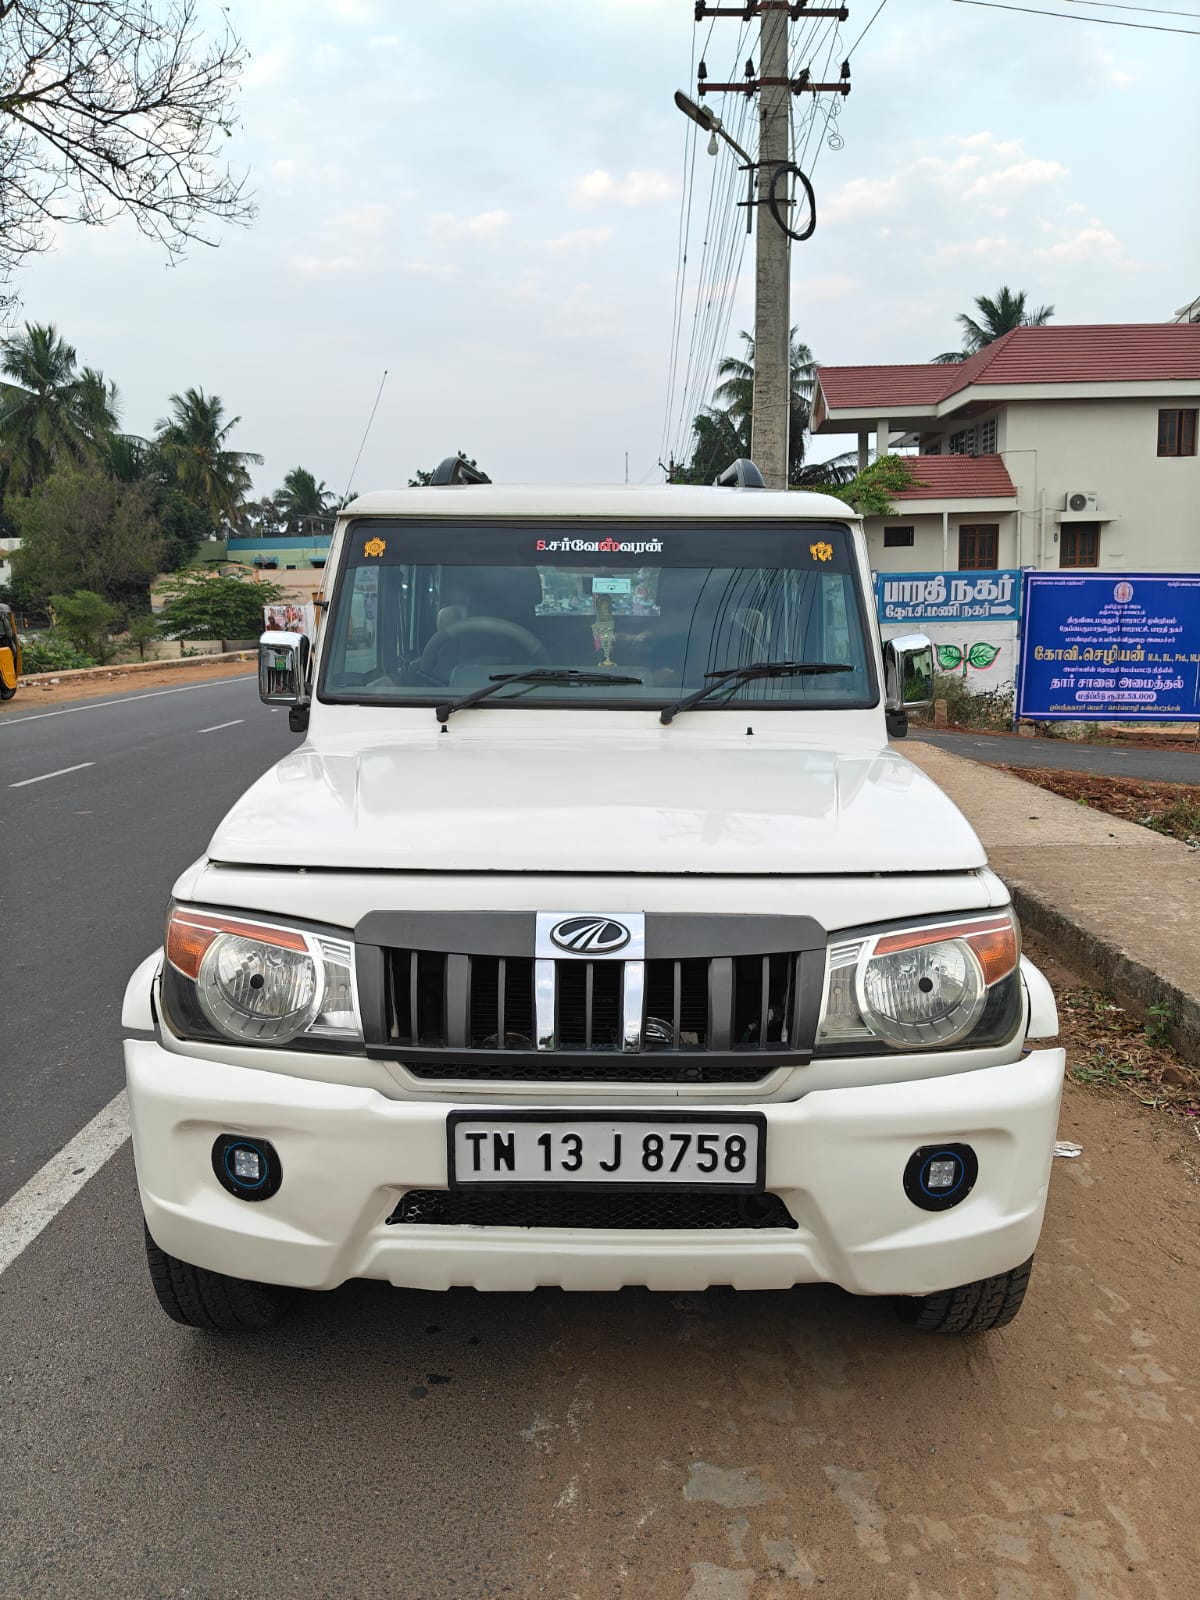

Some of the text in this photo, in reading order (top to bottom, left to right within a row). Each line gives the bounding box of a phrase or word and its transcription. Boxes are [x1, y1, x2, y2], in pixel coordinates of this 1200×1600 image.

[536, 537, 663, 554] S.சர்வேஸ்வரன்
[884, 574, 1015, 606] பாரதி நகர்
[961, 602, 990, 617] நகர்
[1034, 644, 1145, 665] கோவி.செழியன்
[1050, 674, 1184, 691] தார் சாலை அமைத்தல்
[465, 1132, 748, 1173] TN 13 J 8758
